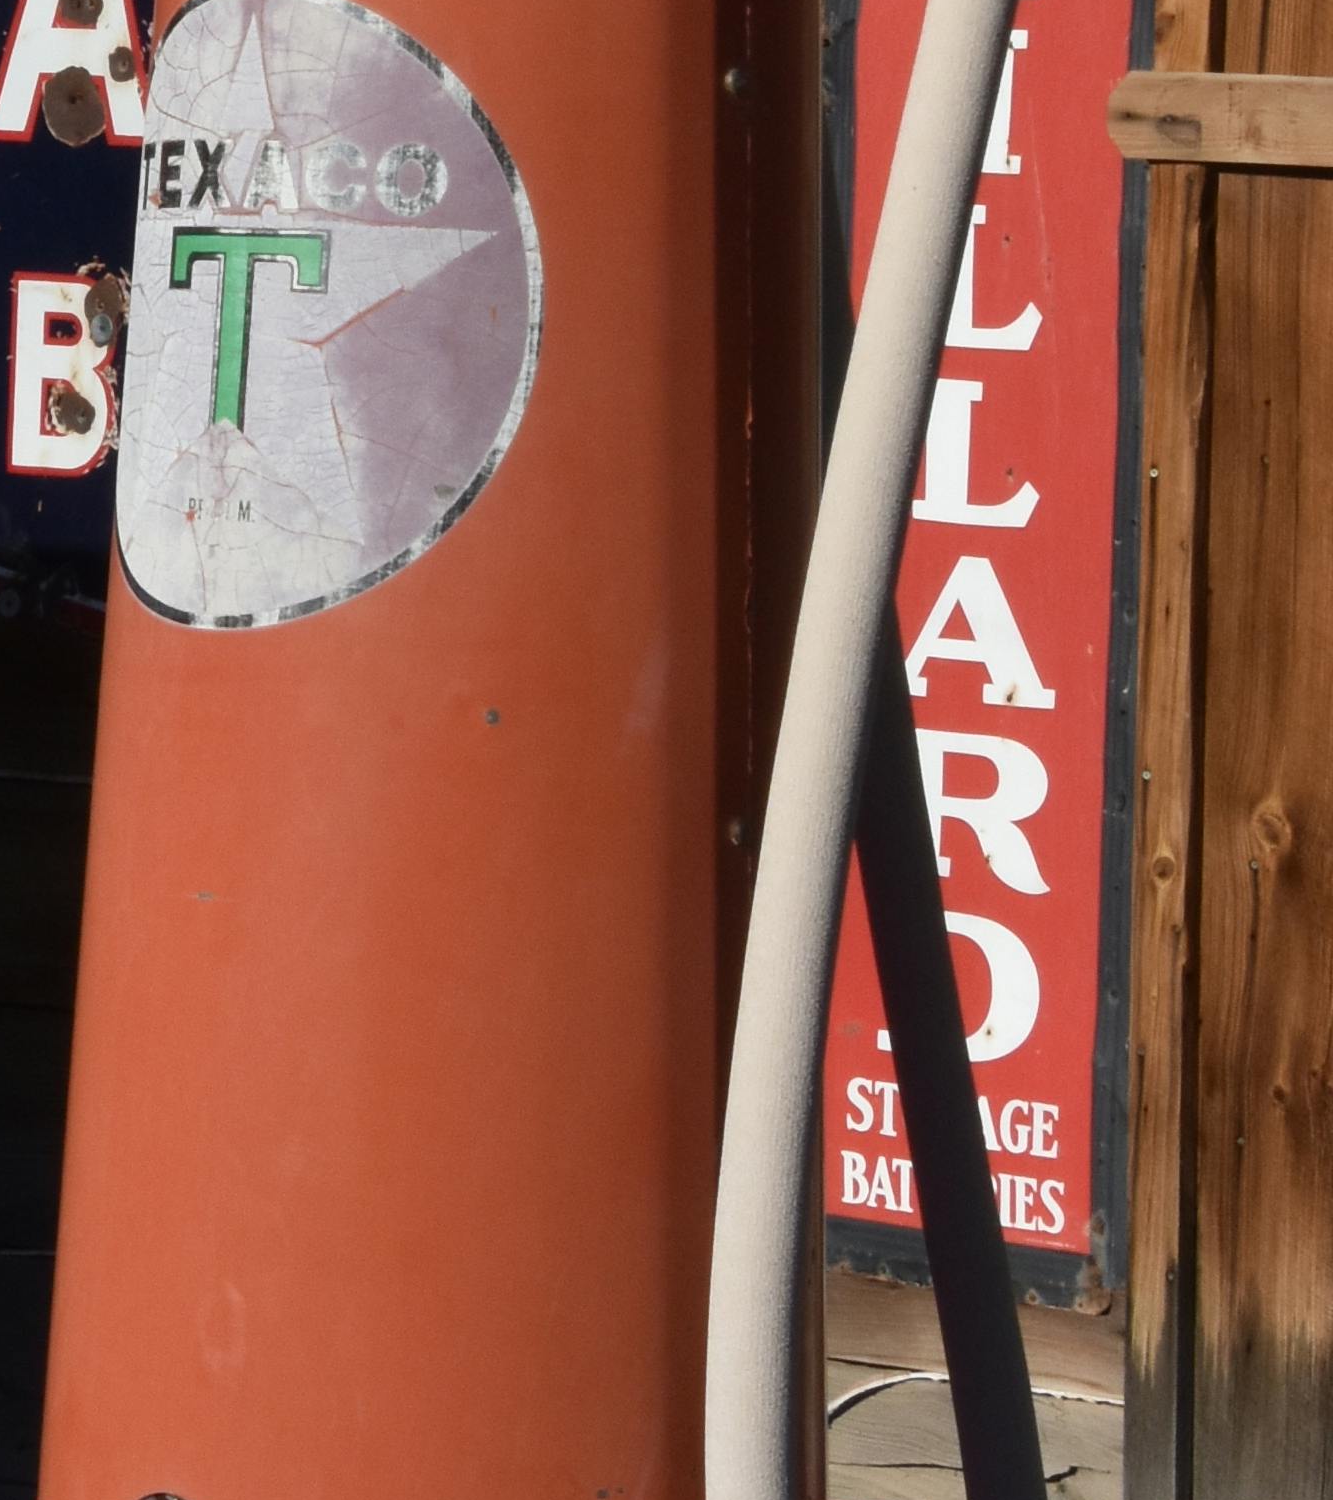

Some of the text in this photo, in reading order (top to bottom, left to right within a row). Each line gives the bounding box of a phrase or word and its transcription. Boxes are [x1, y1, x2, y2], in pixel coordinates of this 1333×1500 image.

[142, 138, 448, 217] TEXACO
[169, 226, 332, 433] T
[846, 1076, 1060, 1160] STAGE
[841, 1149, 1066, 1235] BATIES
